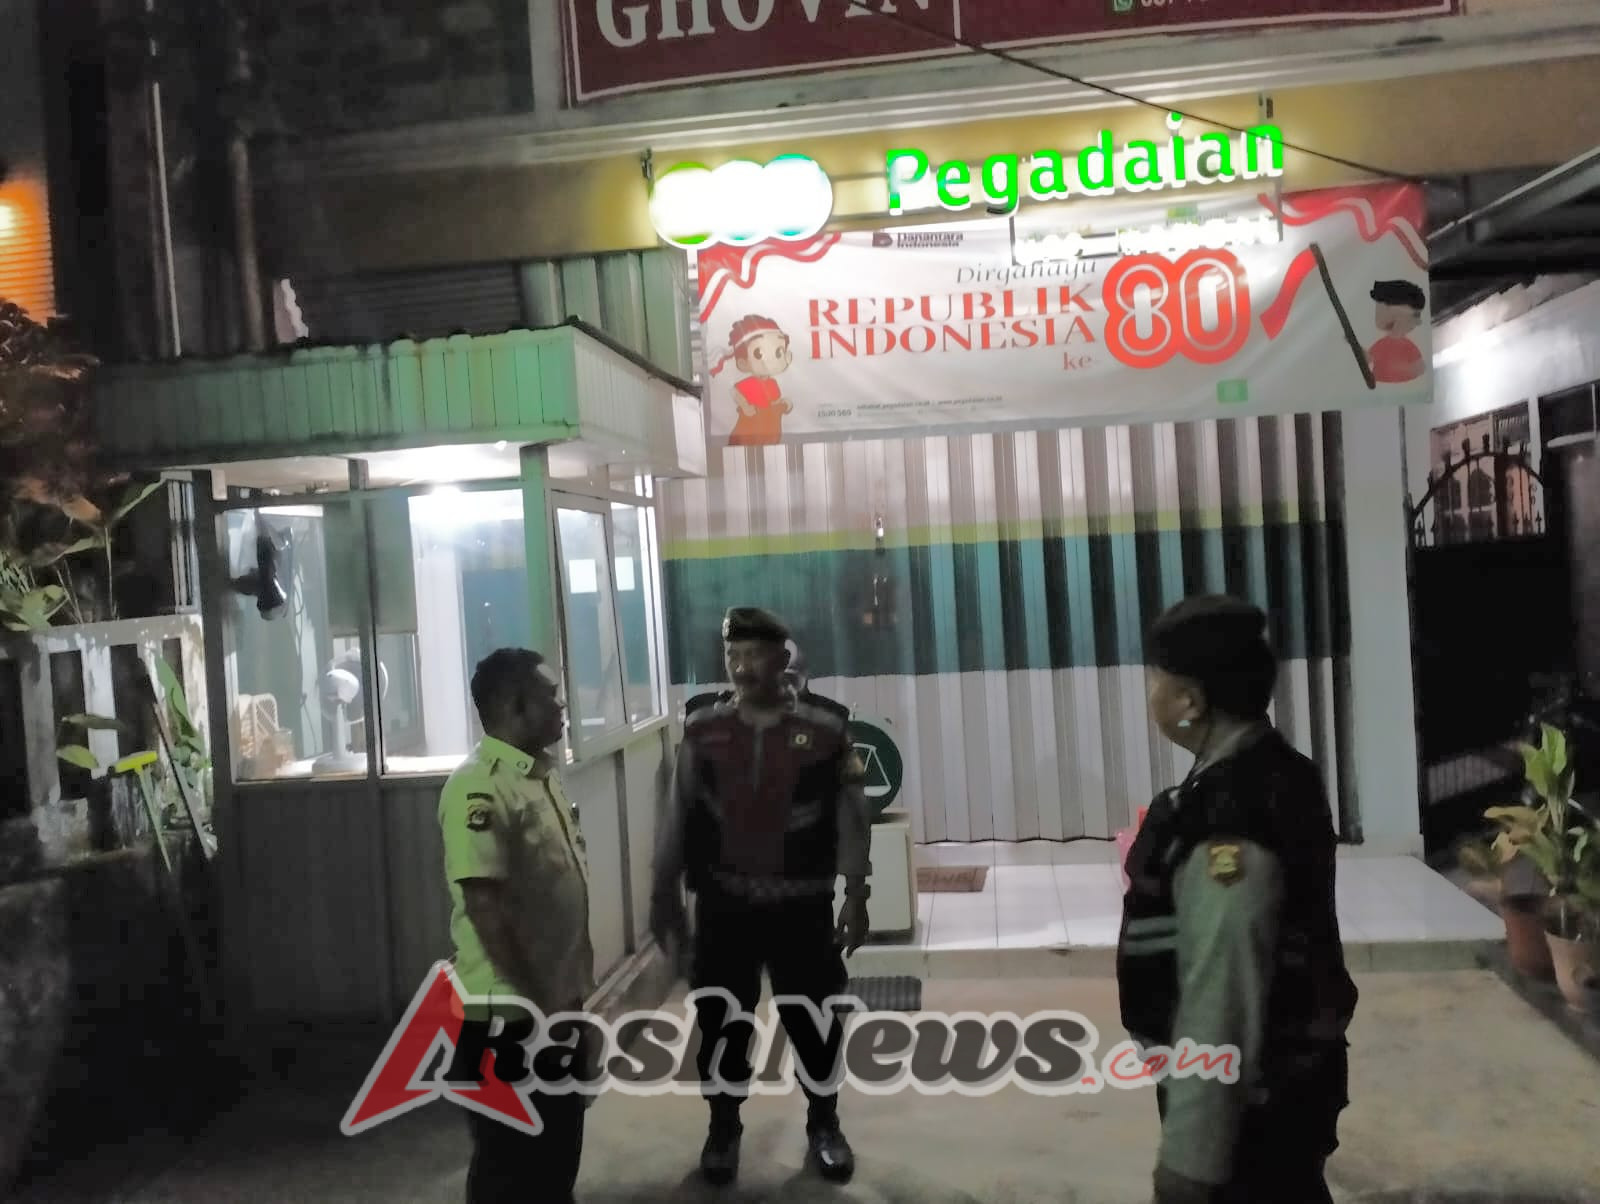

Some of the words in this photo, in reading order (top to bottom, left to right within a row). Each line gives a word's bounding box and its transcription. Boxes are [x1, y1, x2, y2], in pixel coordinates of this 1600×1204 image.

[886, 112, 1284, 215] Pegadaian
[808, 283, 1096, 327] REPUBLIK
[808, 315, 1096, 360] INDONESIA
[1062, 350, 1093, 372] ke
[1102, 248, 1251, 370] 80
